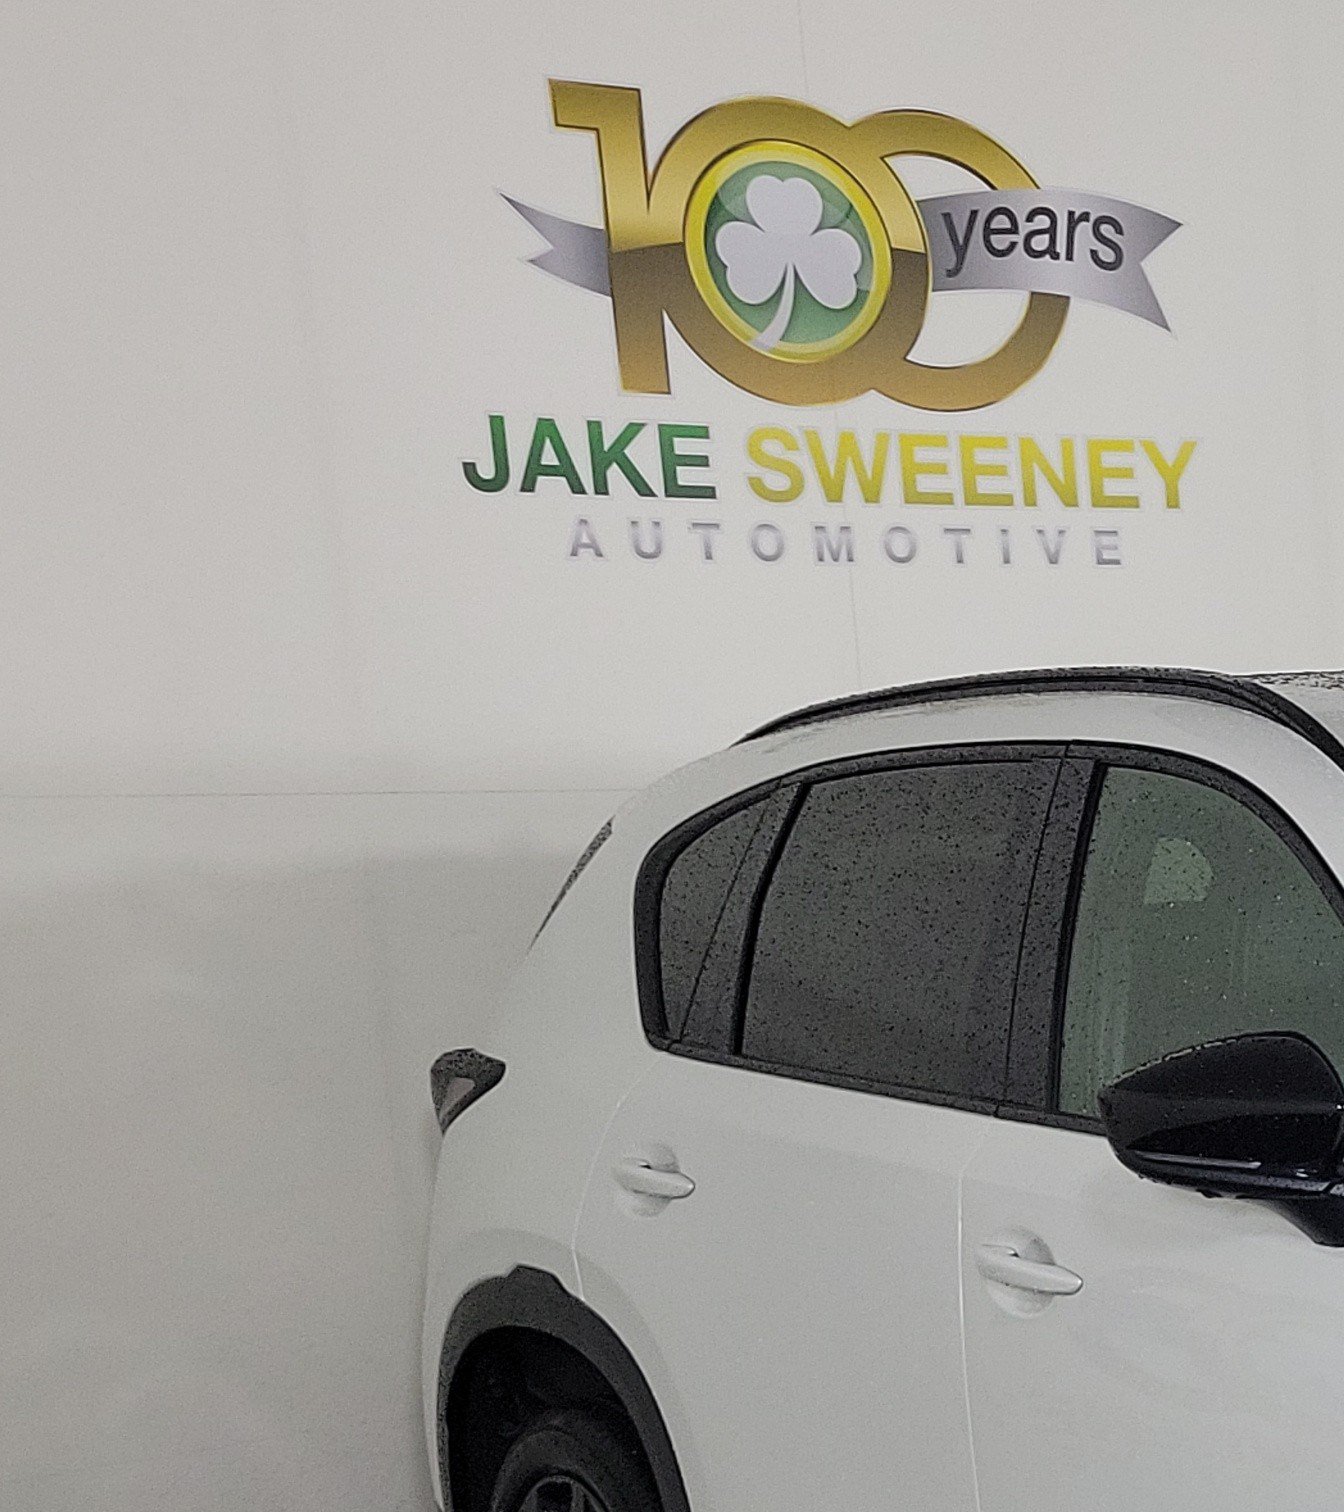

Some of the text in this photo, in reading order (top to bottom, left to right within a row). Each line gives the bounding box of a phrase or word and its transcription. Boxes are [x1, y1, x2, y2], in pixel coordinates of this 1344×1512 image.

[546, 77, 1126, 413] 100 years
[461, 414, 1198, 510] JAKE SWEENEY
[568, 517, 1122, 566] AUTOMOTIVE
